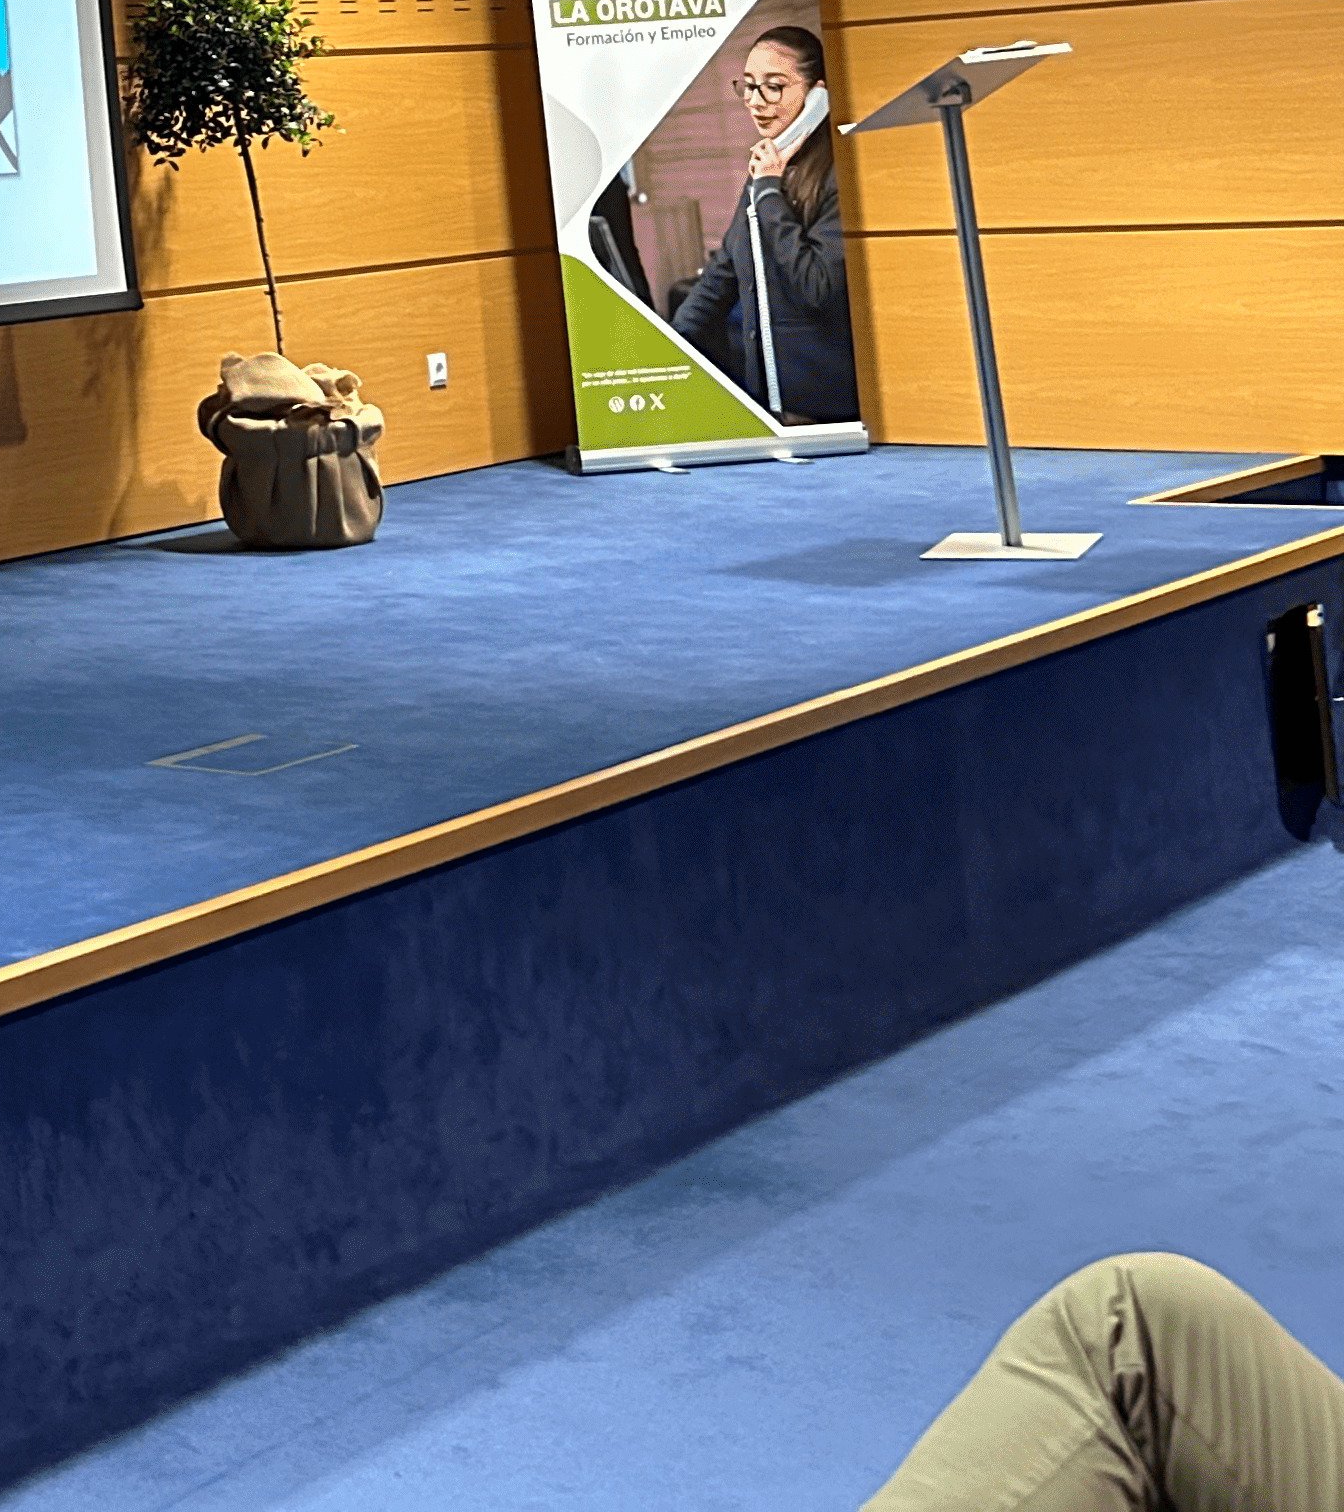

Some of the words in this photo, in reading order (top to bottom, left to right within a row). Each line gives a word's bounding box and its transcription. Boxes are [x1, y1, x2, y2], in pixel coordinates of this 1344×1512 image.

[552, 0, 590, 25] LA
[566, 28, 645, 47] Formación
[647, 30, 658, 45] y
[660, 25, 717, 42] Empleo
